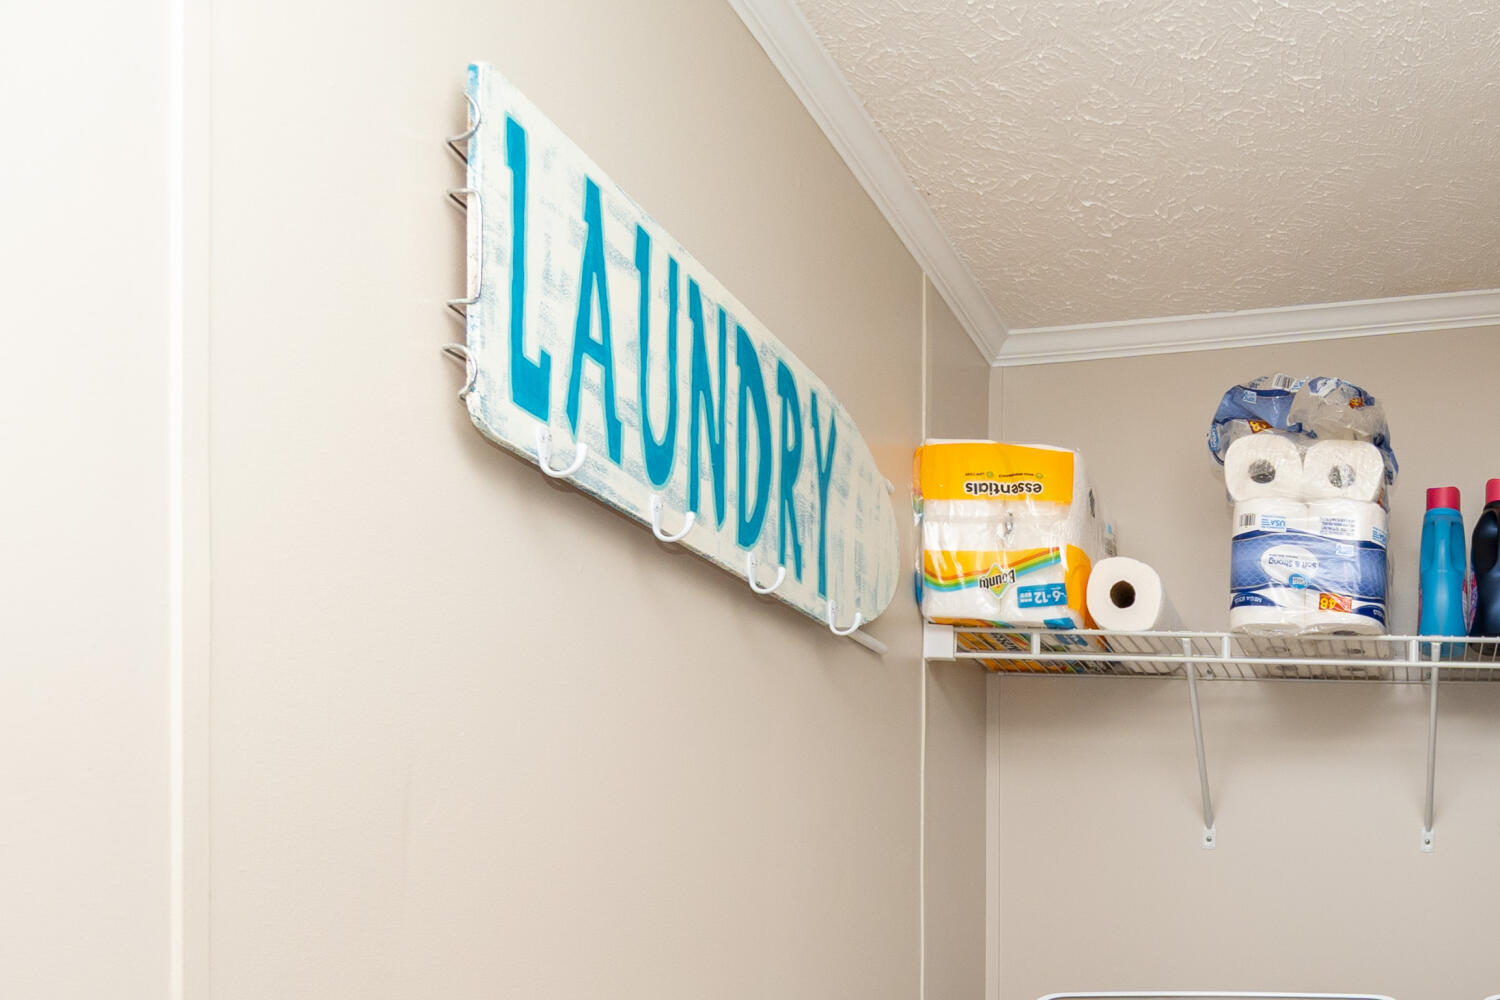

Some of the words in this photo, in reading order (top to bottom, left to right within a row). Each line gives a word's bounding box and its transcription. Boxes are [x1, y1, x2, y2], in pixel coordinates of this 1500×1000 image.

[505, 114, 837, 598] LAUNDRY
[965, 482, 1042, 495] essentials
[1268, 557, 1293, 568] Strong
[979, 569, 1016, 590] Bounty
[1033, 592, 1048, 604] 12
[1320, 597, 1337, 609] 48
